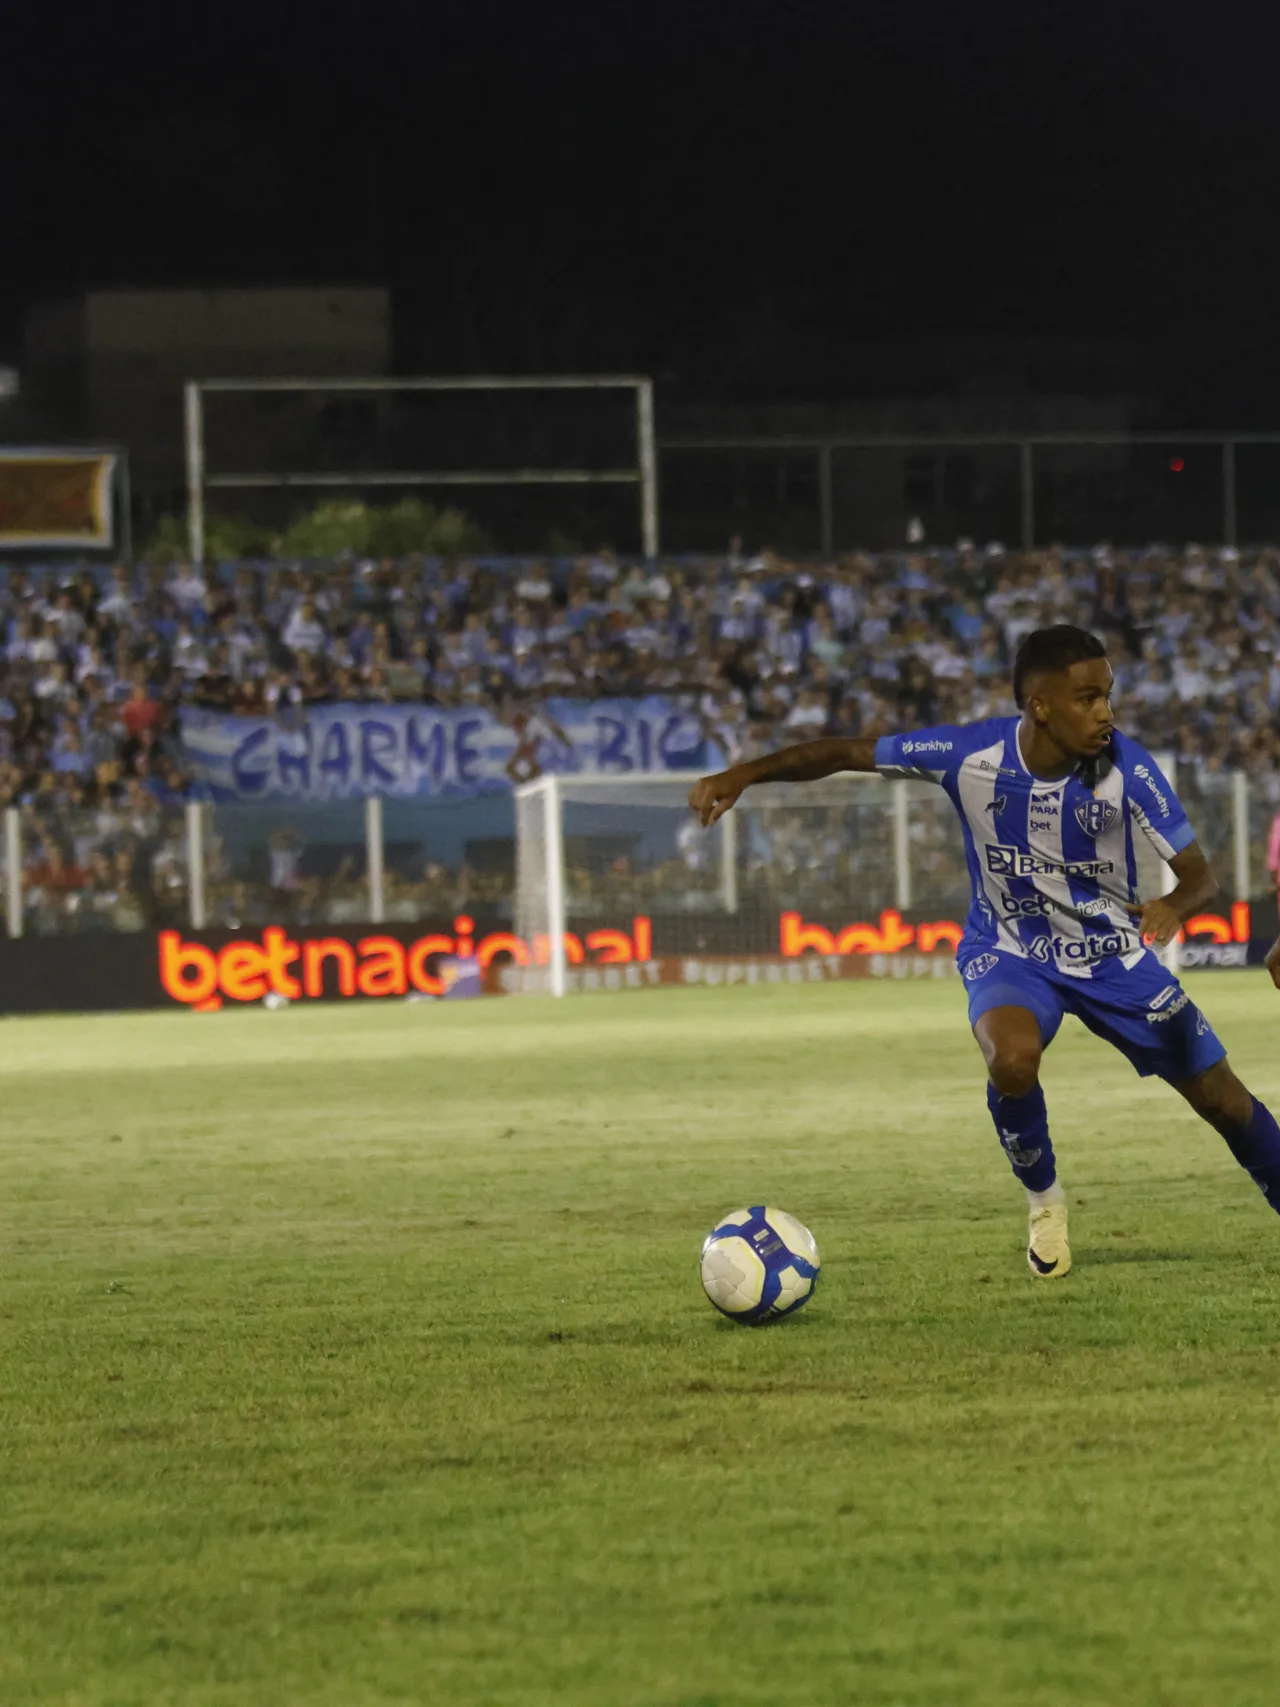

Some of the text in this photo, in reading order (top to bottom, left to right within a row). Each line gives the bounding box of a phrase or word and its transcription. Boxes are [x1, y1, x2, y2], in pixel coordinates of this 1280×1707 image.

[914, 741, 953, 754] Sankhya
[231, 717, 482, 793] CHARME
[1030, 819, 1052, 833] bet
